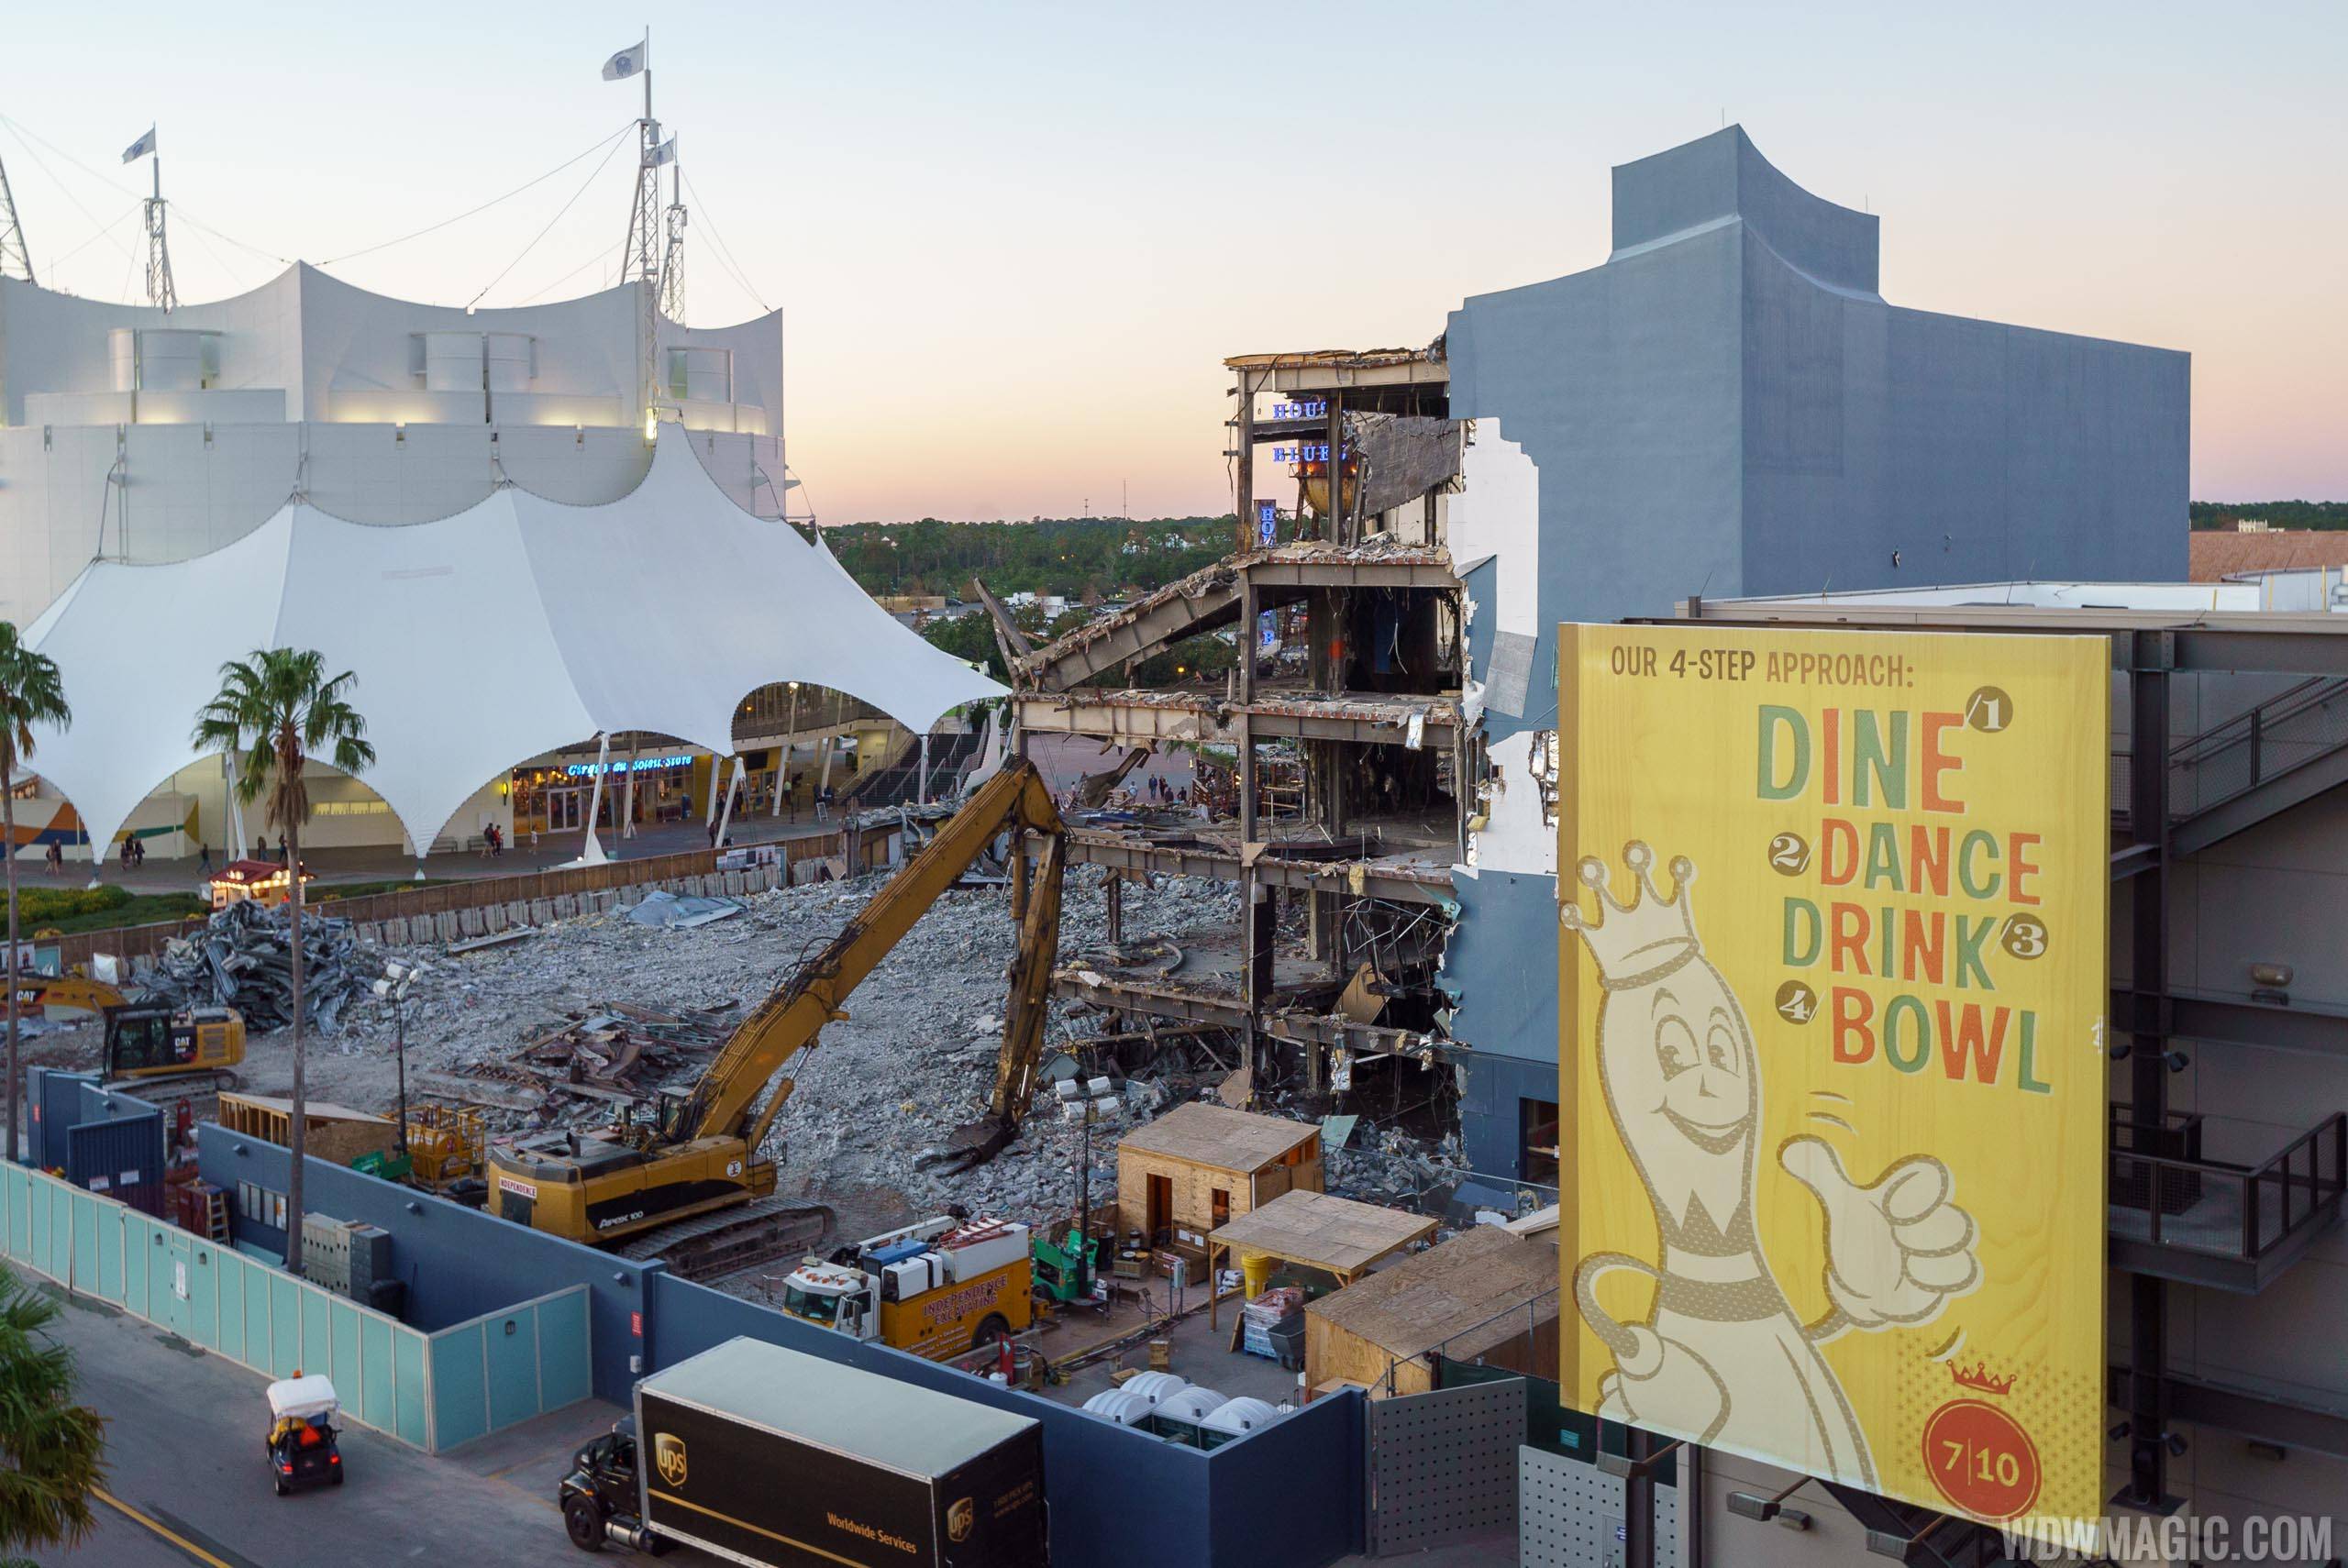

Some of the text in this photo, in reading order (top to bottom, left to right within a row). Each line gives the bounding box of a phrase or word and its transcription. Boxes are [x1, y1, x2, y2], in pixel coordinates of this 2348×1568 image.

[1611, 646, 1914, 688] OUR 4-STEP APPROACH:
[1757, 703, 1966, 814] DINE
[1819, 817, 2042, 906] DANCE
[1782, 896, 1998, 991] DRINK
[17, 989, 36, 1002] CAT
[174, 1035, 190, 1047] CAT
[1832, 986, 2052, 1095] BOWL
[827, 1511, 916, 1554] Worldwide Services
